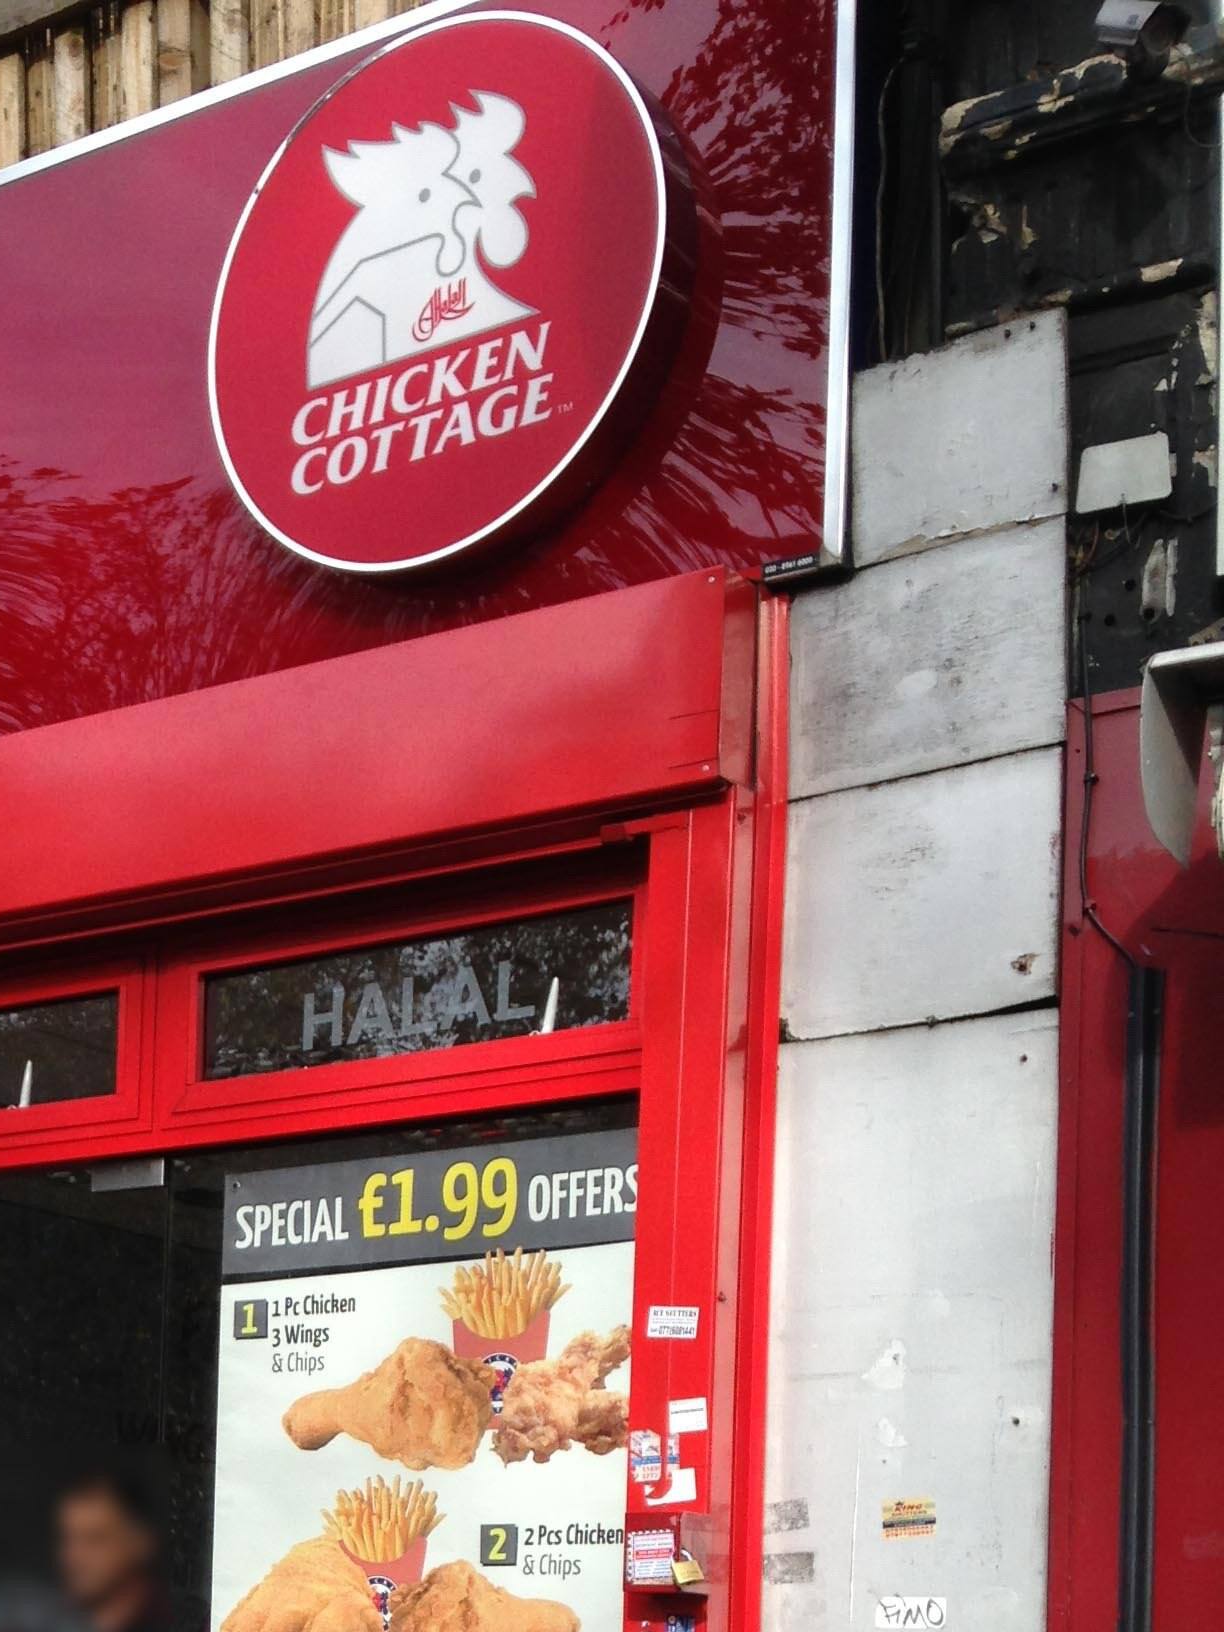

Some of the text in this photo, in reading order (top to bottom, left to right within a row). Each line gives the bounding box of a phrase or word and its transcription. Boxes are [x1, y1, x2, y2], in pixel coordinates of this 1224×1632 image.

[291, 321, 551, 446] CHICKEN
[558, 401, 574, 414] TM
[291, 373, 553, 495] COTTAGE
[302, 960, 536, 1050] HALAL
[235, 1157, 639, 1249] SPECIAL £1.99 OFFERS
[241, 1293, 356, 1334] 1 1 Pc Chicken
[272, 1324, 329, 1347] 3 Wings
[271, 1352, 325, 1376] & Chips
[488, 1523, 624, 1560] 2 2 Pcs Chicken
[522, 1553, 582, 1580] & Chips
